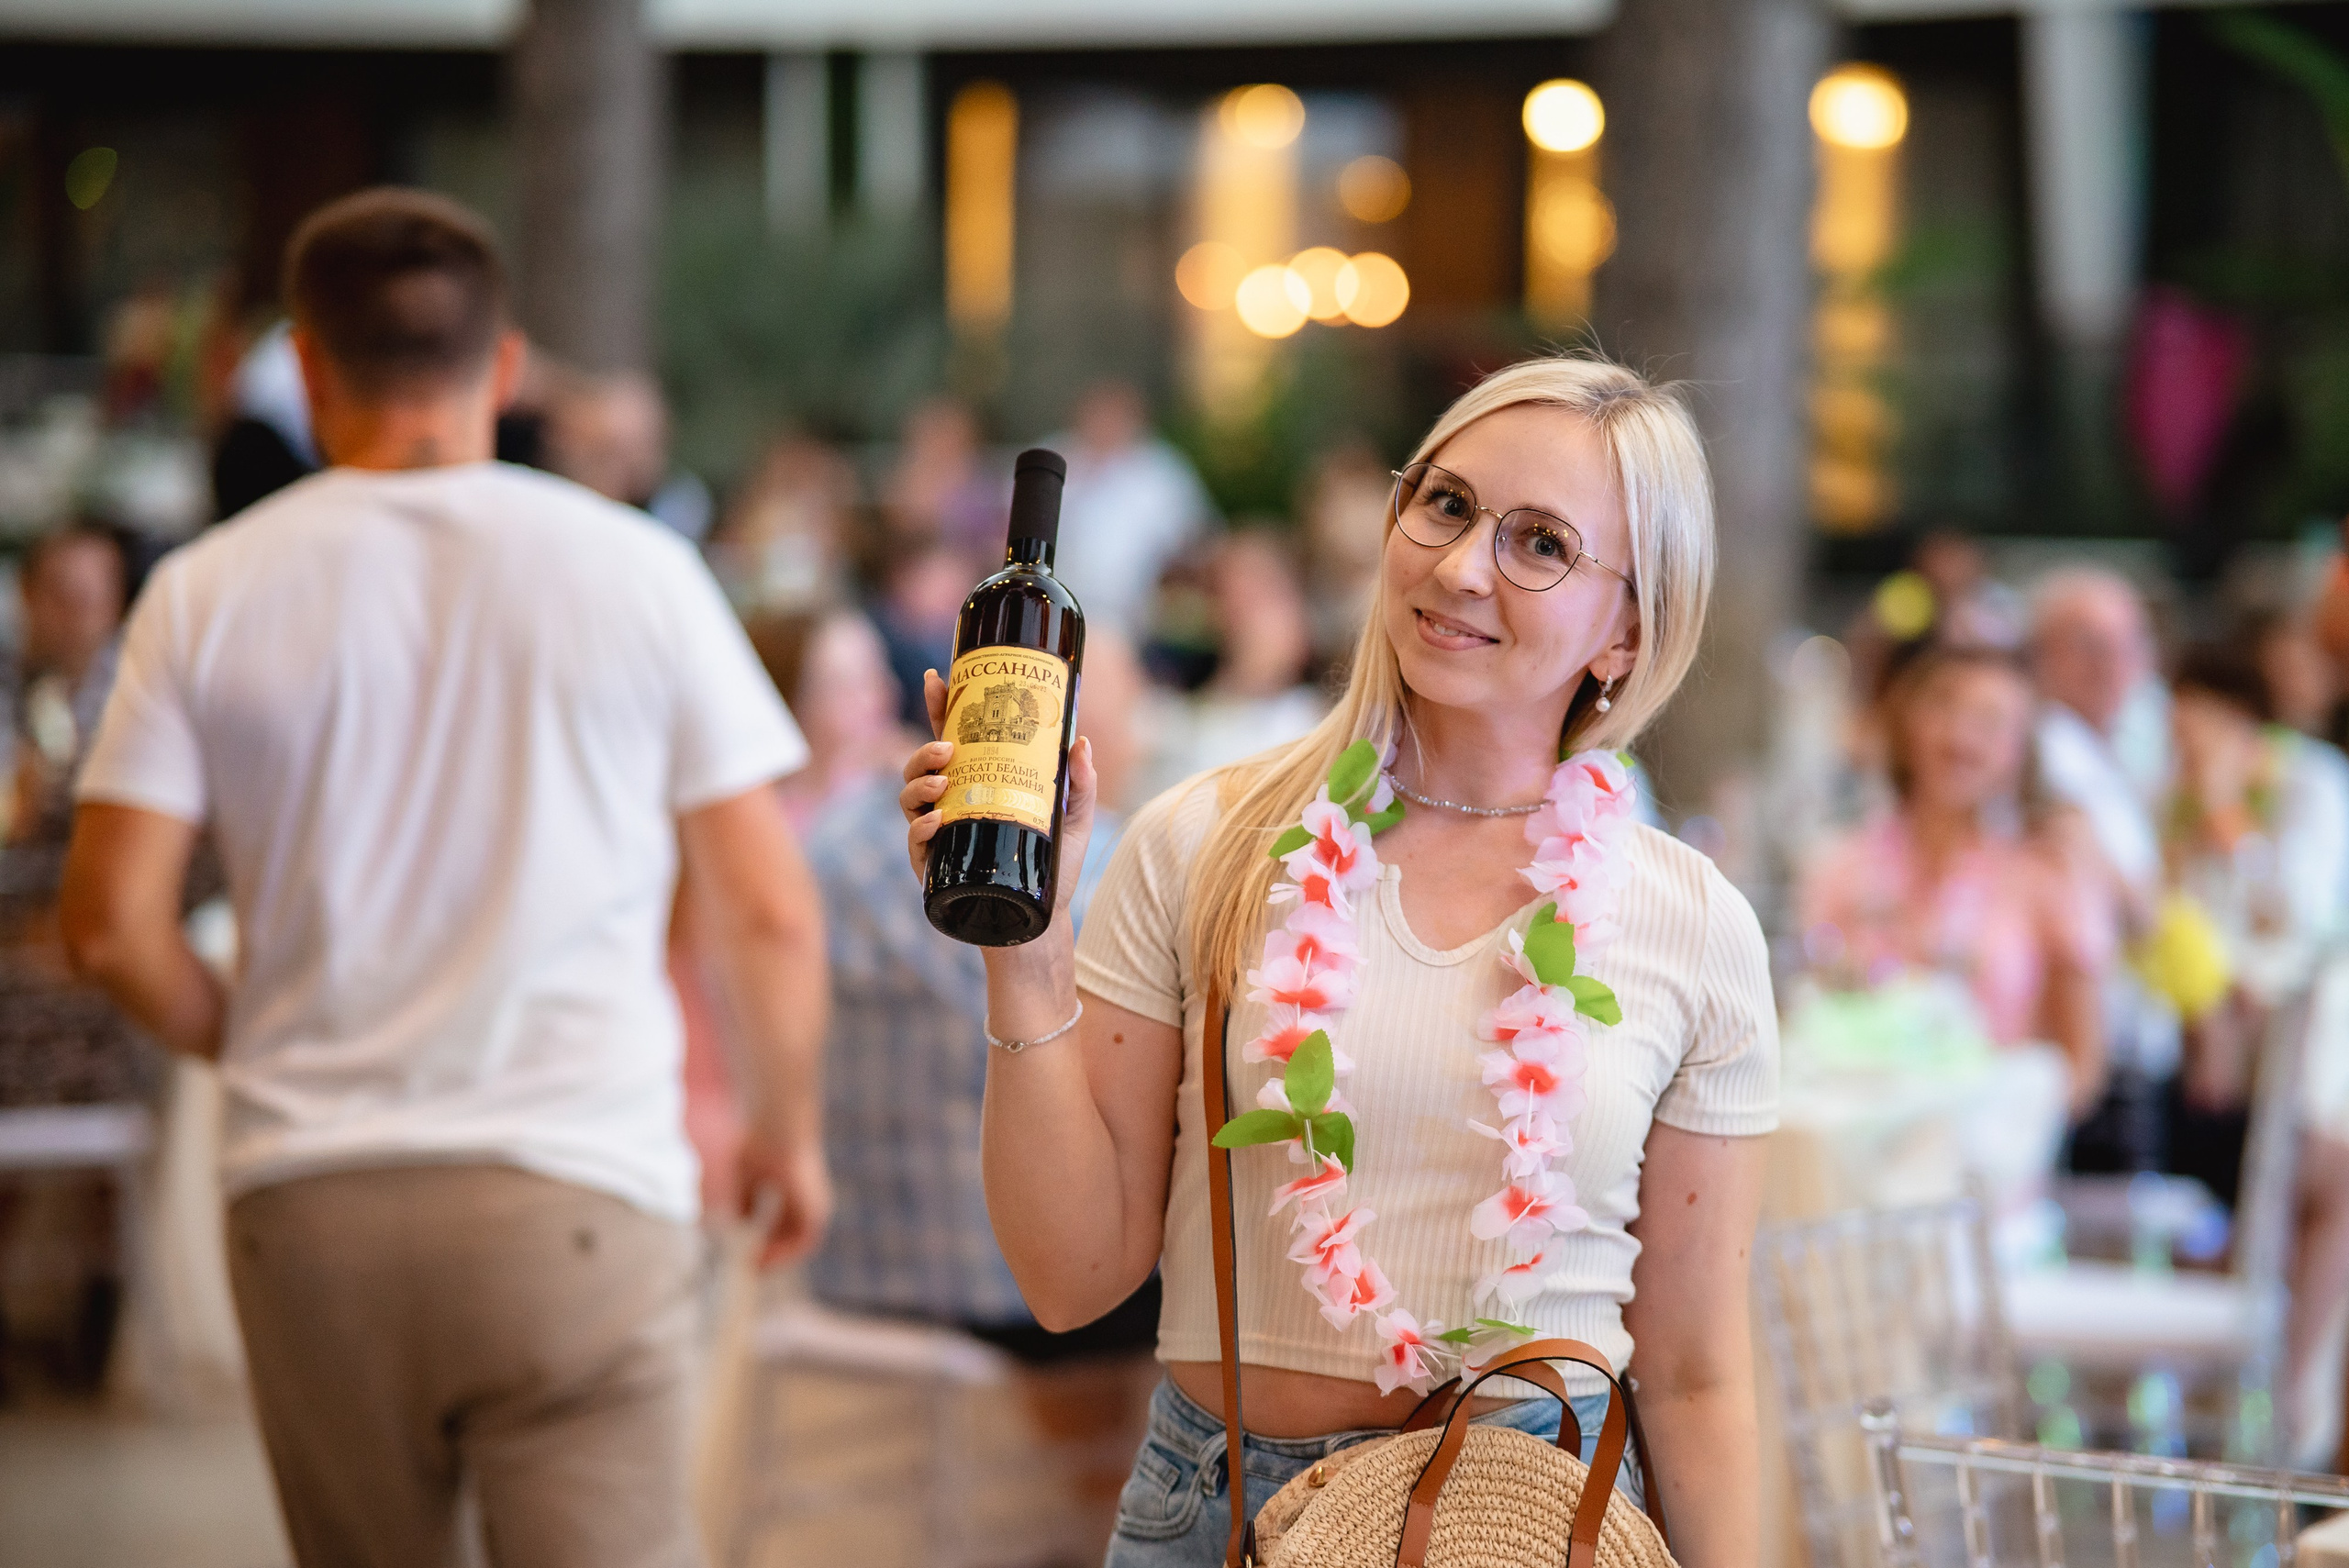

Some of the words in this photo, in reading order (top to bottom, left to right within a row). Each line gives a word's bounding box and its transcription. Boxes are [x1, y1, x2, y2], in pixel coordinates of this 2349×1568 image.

[951, 662, 1062, 689] МАССАНДРА
[983, 746, 999, 756] 1894
[948, 762, 993, 778] МУСКАТ
[996, 763, 1039, 780] БЕЛЫЙ
[947, 773, 997, 790] РАСНОГО
[1001, 774, 1044, 794] КАМНЯ
